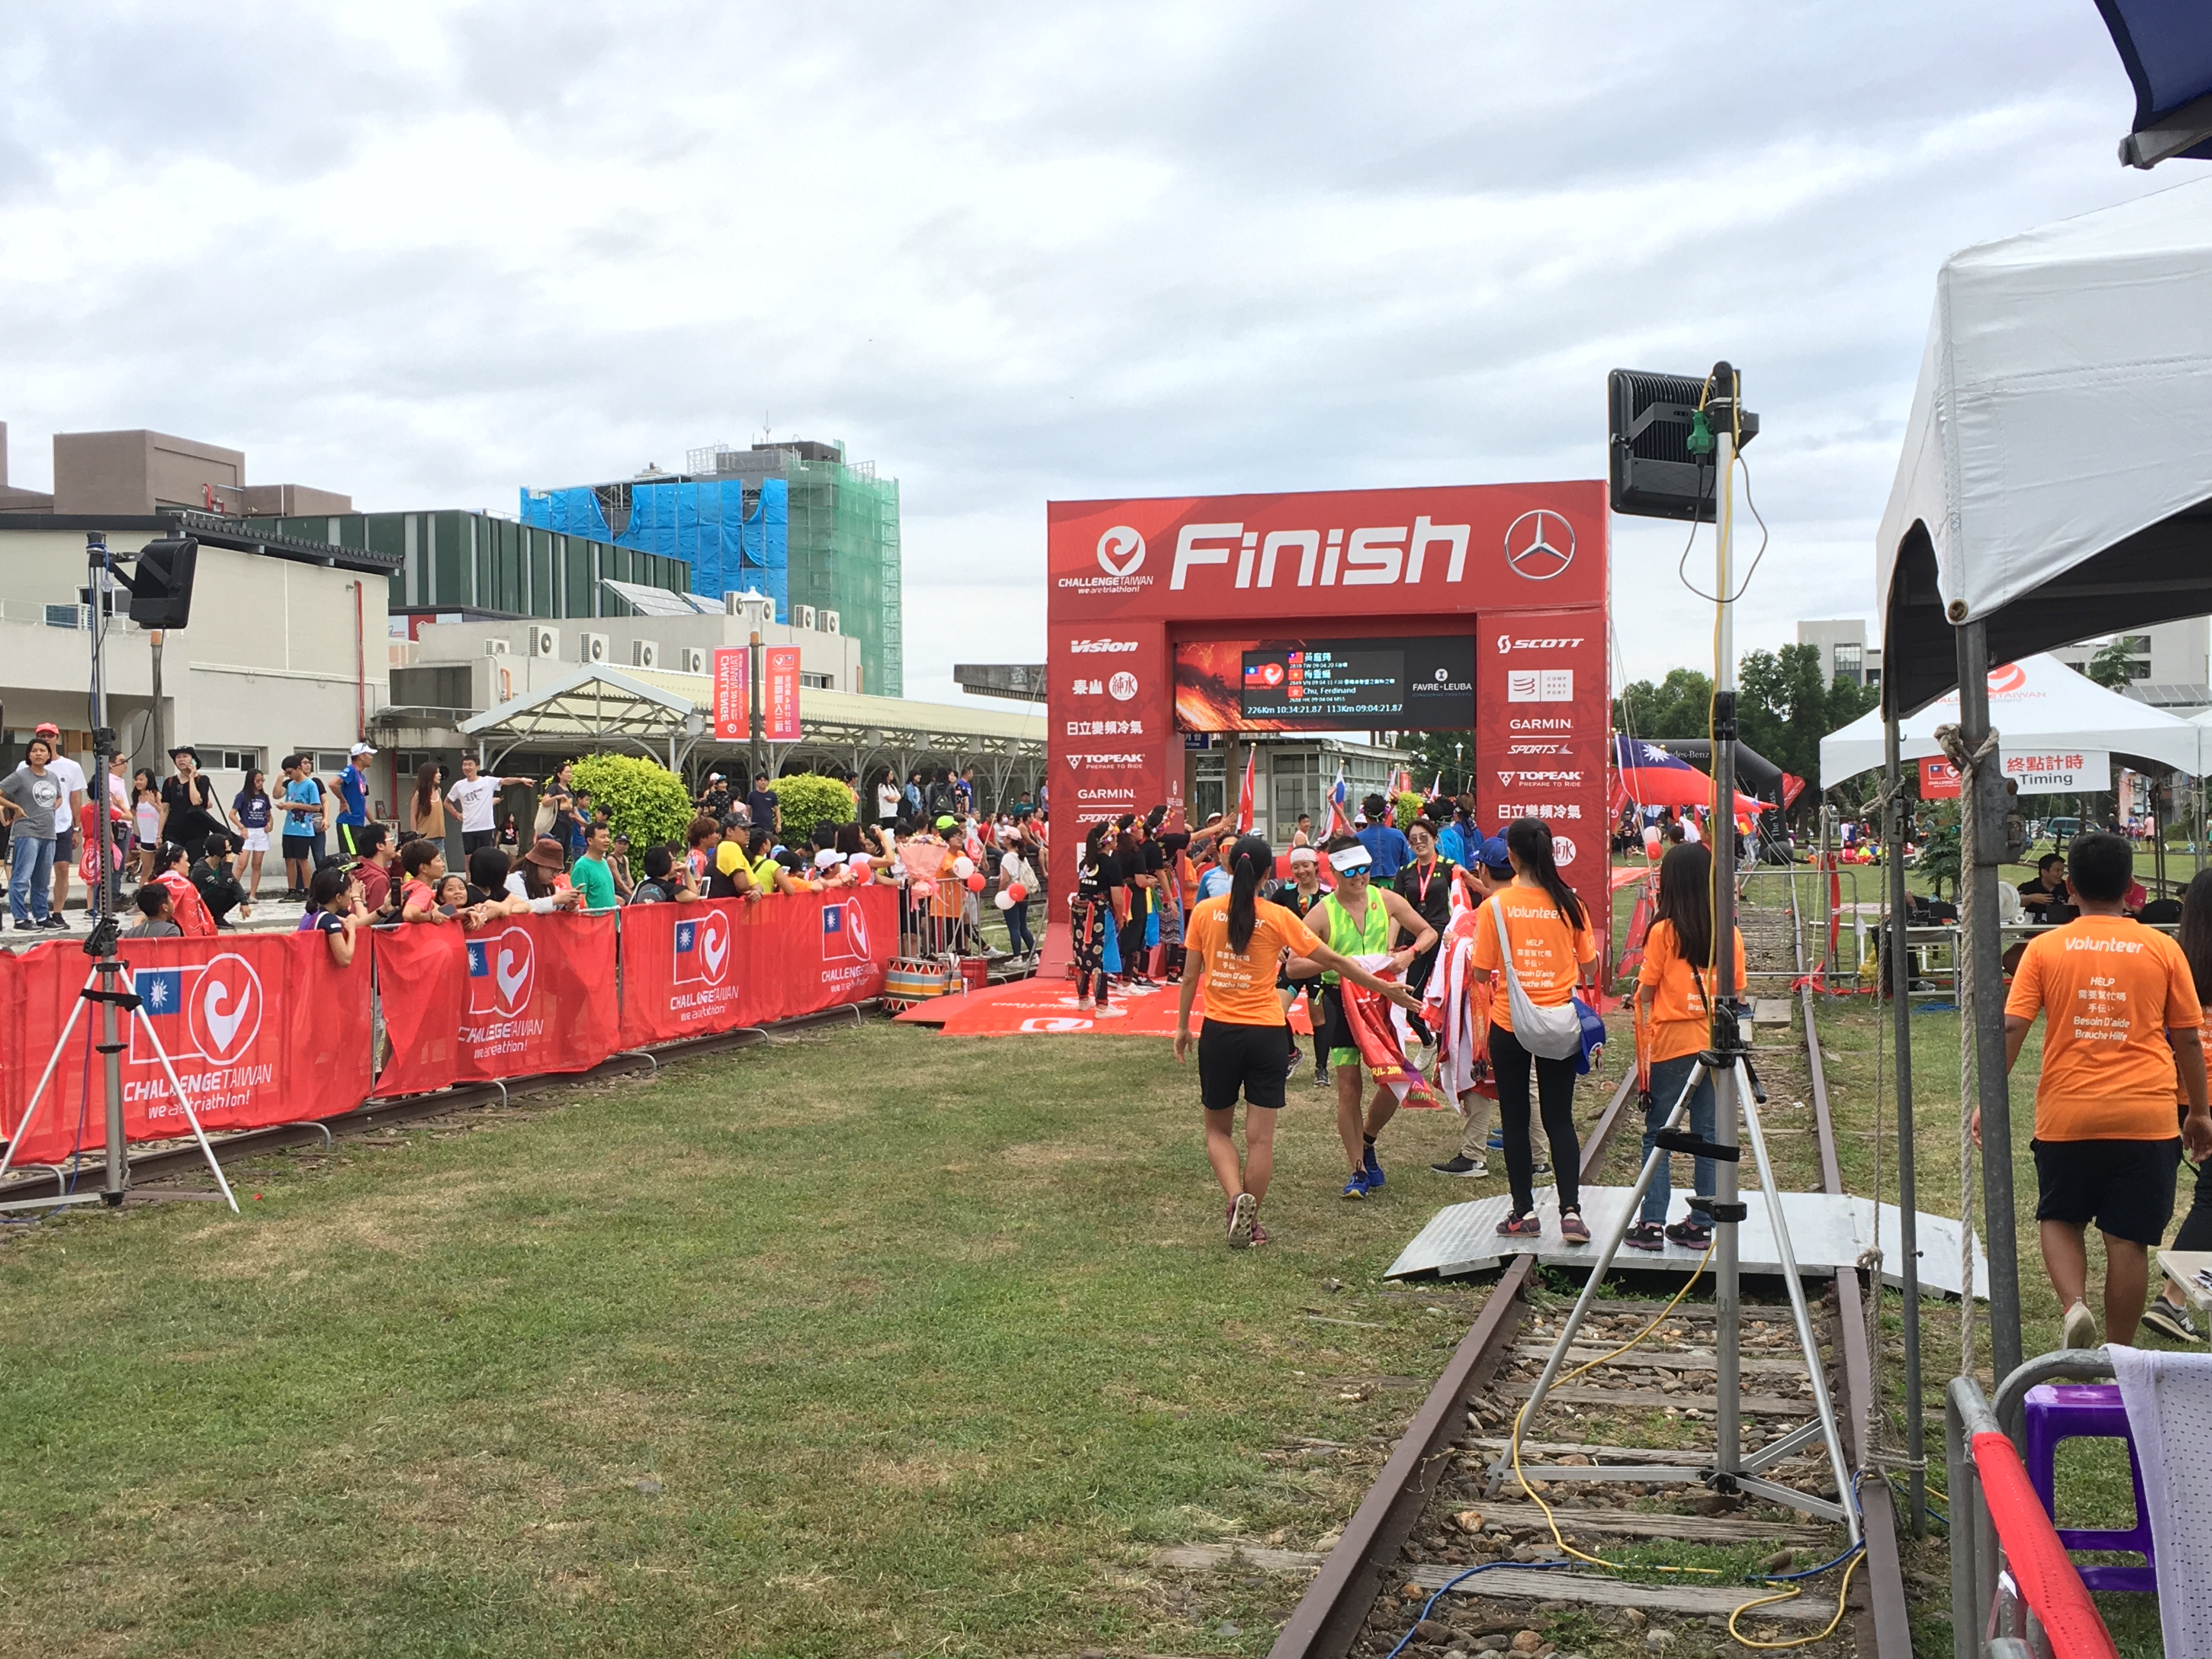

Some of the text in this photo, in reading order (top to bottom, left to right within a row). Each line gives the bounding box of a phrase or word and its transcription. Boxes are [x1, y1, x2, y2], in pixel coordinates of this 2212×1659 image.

[1169, 516, 1471, 590] Finish
[1071, 639, 1138, 653] Vision
[1513, 638, 1584, 648] SCOTT
[1072, 679, 1103, 695] 泰山
[1112, 676, 1136, 695] 純水
[1303, 686, 1356, 695] Chu, Ferdinand
[1413, 683, 1472, 691] FAVRE-LEUBA
[1247, 704, 1403, 714] 226Km 10:34:21.87 113Km 09:04:21.87
[1067, 720, 1143, 736] 日立變頻冷氣
[1510, 719, 1571, 729] GARMIN
[1507, 745, 1560, 754] SPORTS
[1084, 754, 1143, 763] TOPEAK
[2006, 754, 2084, 772] 終點計時
[1517, 771, 1582, 780] TOPEAK
[2019, 773, 2073, 786] Timing
[1077, 789, 1134, 799] GARMIN
[1771, 822, 1780, 837] The
[2066, 936, 2144, 953] Volunteer
[1212, 970, 1232, 979] Besoin
[2090, 977, 2115, 986] HELP
[2074, 1015, 2103, 1026] Besoin
[2075, 1029, 2128, 1041] Brauche Hilfe
[1372, 1067, 1386, 1076] RIL
[149, 1104, 166, 1119] we
